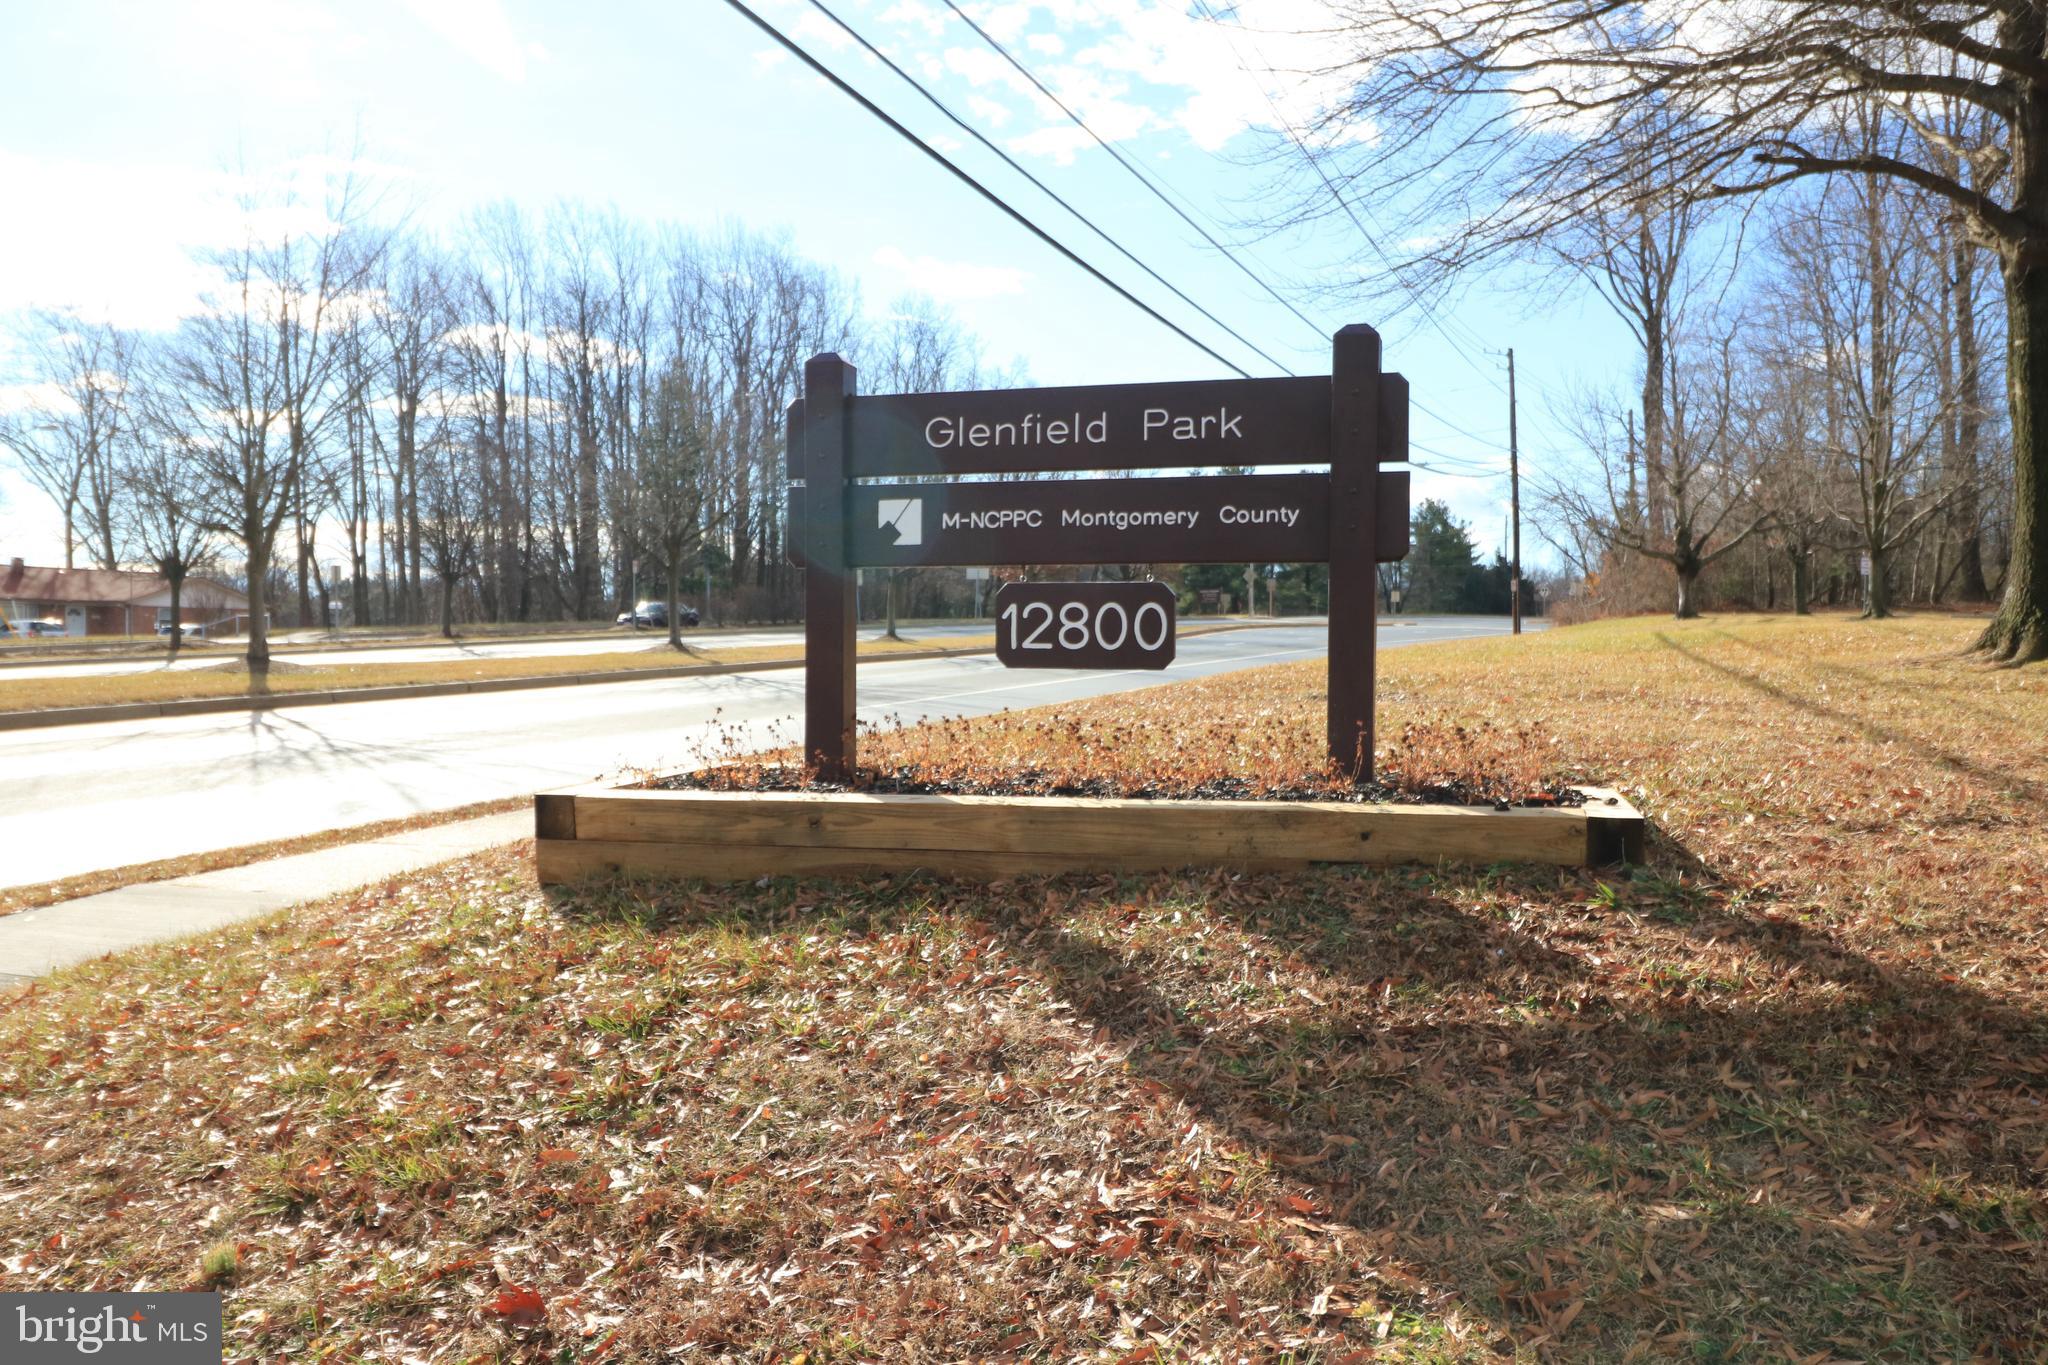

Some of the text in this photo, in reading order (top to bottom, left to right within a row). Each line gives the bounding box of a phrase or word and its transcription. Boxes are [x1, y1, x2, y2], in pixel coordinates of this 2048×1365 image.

[925, 407, 1243, 449] Glenfield Park
[942, 505, 1300, 531] M-NCPPC Montgomery County
[1001, 601, 1168, 651] 12800
